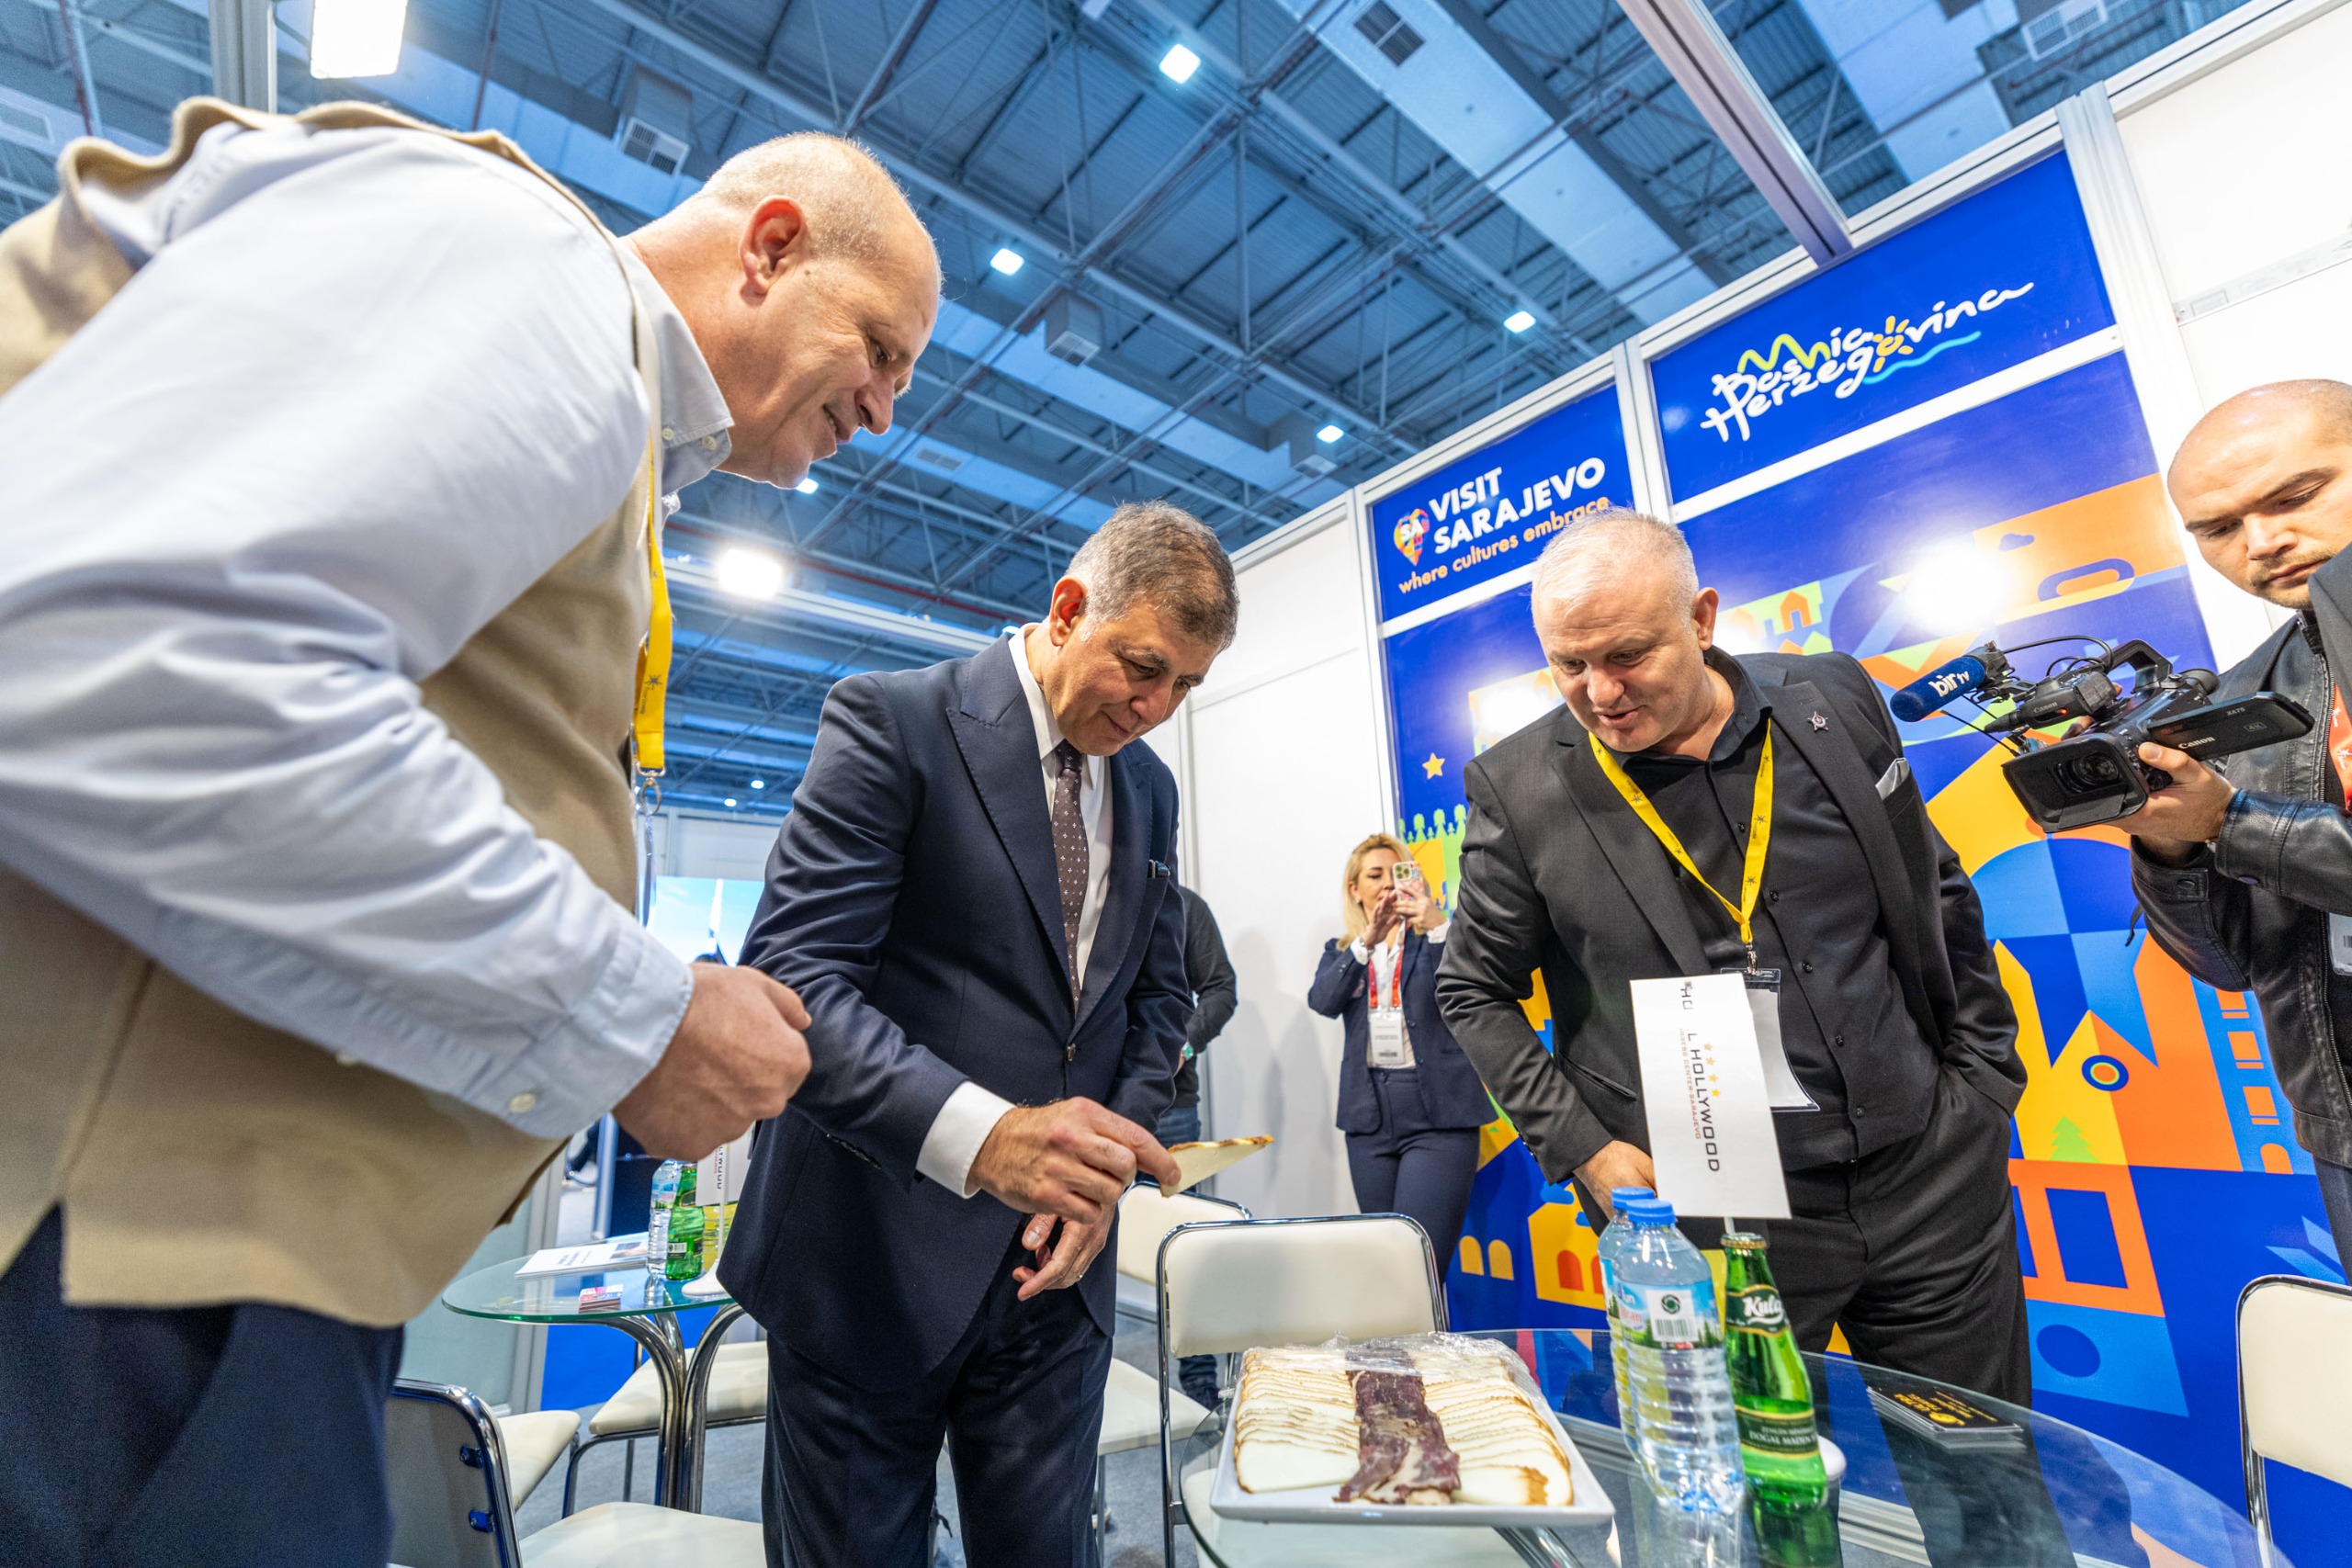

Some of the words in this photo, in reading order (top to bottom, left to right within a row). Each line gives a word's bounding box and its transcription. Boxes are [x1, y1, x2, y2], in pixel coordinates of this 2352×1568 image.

[1700, 282, 2035, 442] Herzegovina
[1428, 466, 1503, 523] VISIT
[1433, 457, 1607, 555] SARAJEVO
[1397, 564, 1449, 594] where
[1452, 534, 1519, 573] cultures
[1522, 496, 1610, 543] embrace
[1399, 518, 1425, 543] SA
[1928, 672, 1958, 697] bir
[1957, 671, 1971, 685] tv
[2033, 701, 2059, 715] Canon
[2177, 736, 2216, 750] Canon
[1690, 1048, 1721, 1172] HOLLYWOOD
